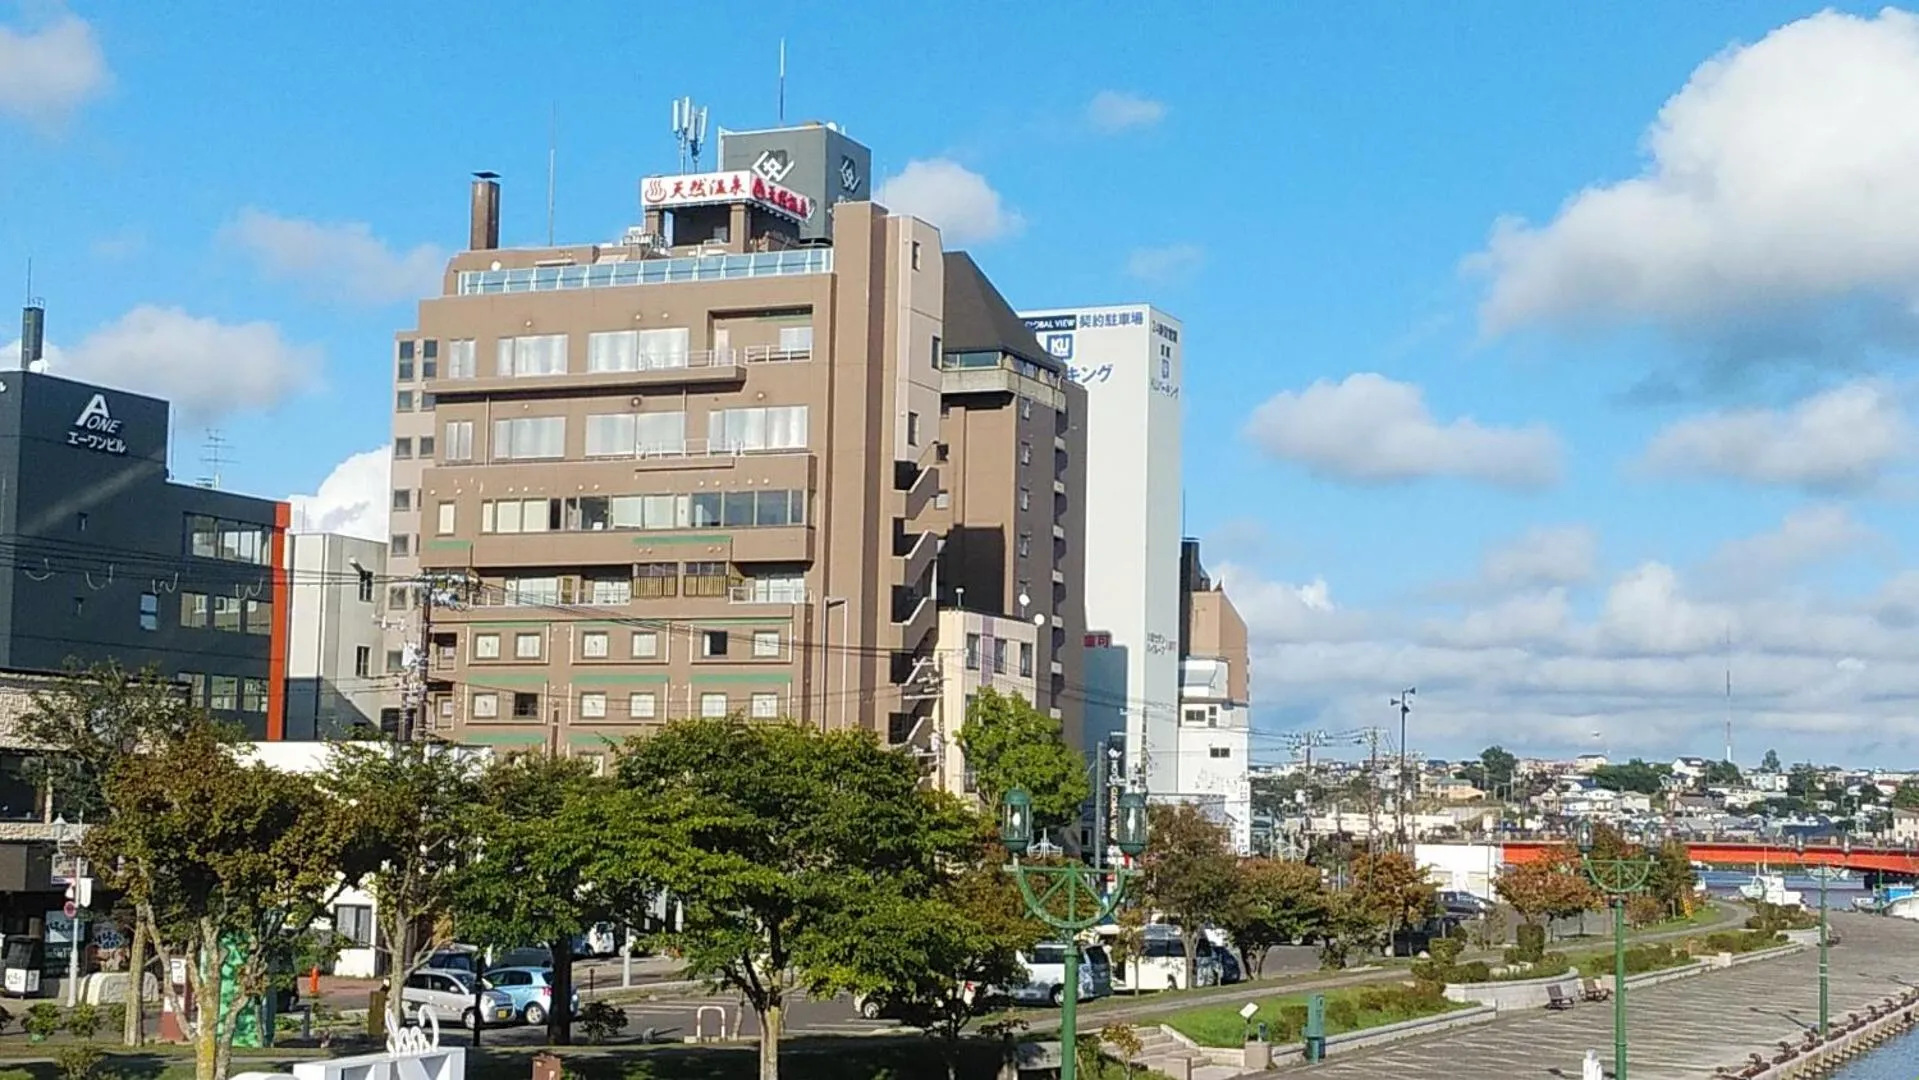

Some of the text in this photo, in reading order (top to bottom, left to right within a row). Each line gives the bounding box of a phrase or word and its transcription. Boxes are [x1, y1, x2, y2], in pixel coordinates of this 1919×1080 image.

[670, 175, 745, 199] 天然温泉
[1054, 318, 1076, 328] VIEW
[67, 431, 127, 453] エーワンビル
